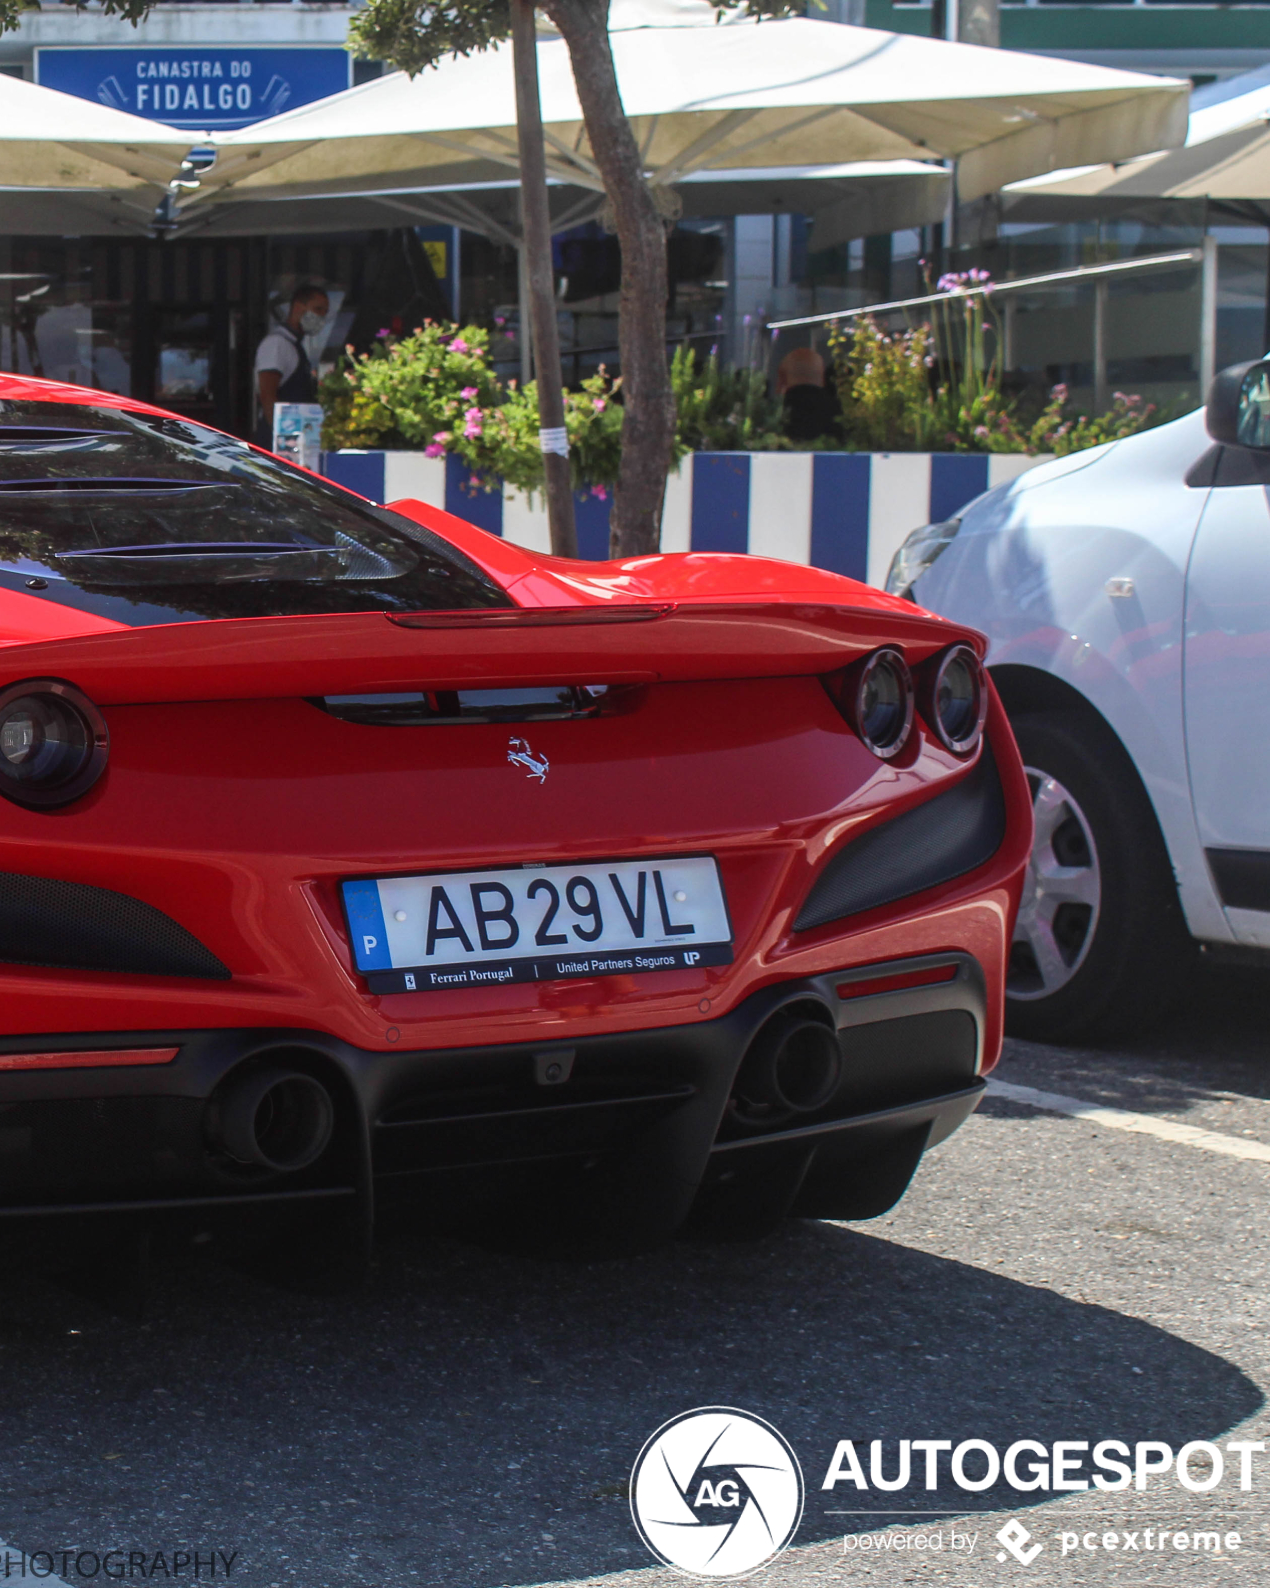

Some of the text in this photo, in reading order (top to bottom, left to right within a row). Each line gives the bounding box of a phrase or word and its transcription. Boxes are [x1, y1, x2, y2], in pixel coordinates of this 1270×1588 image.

[137, 61, 251, 78] CANASTRA DO
[137, 84, 251, 110] FIDALGO
[363, 935, 377, 954] P
[557, 956, 675, 973] United Partners Seguros
[430, 967, 513, 984] Ferrari Portugal
